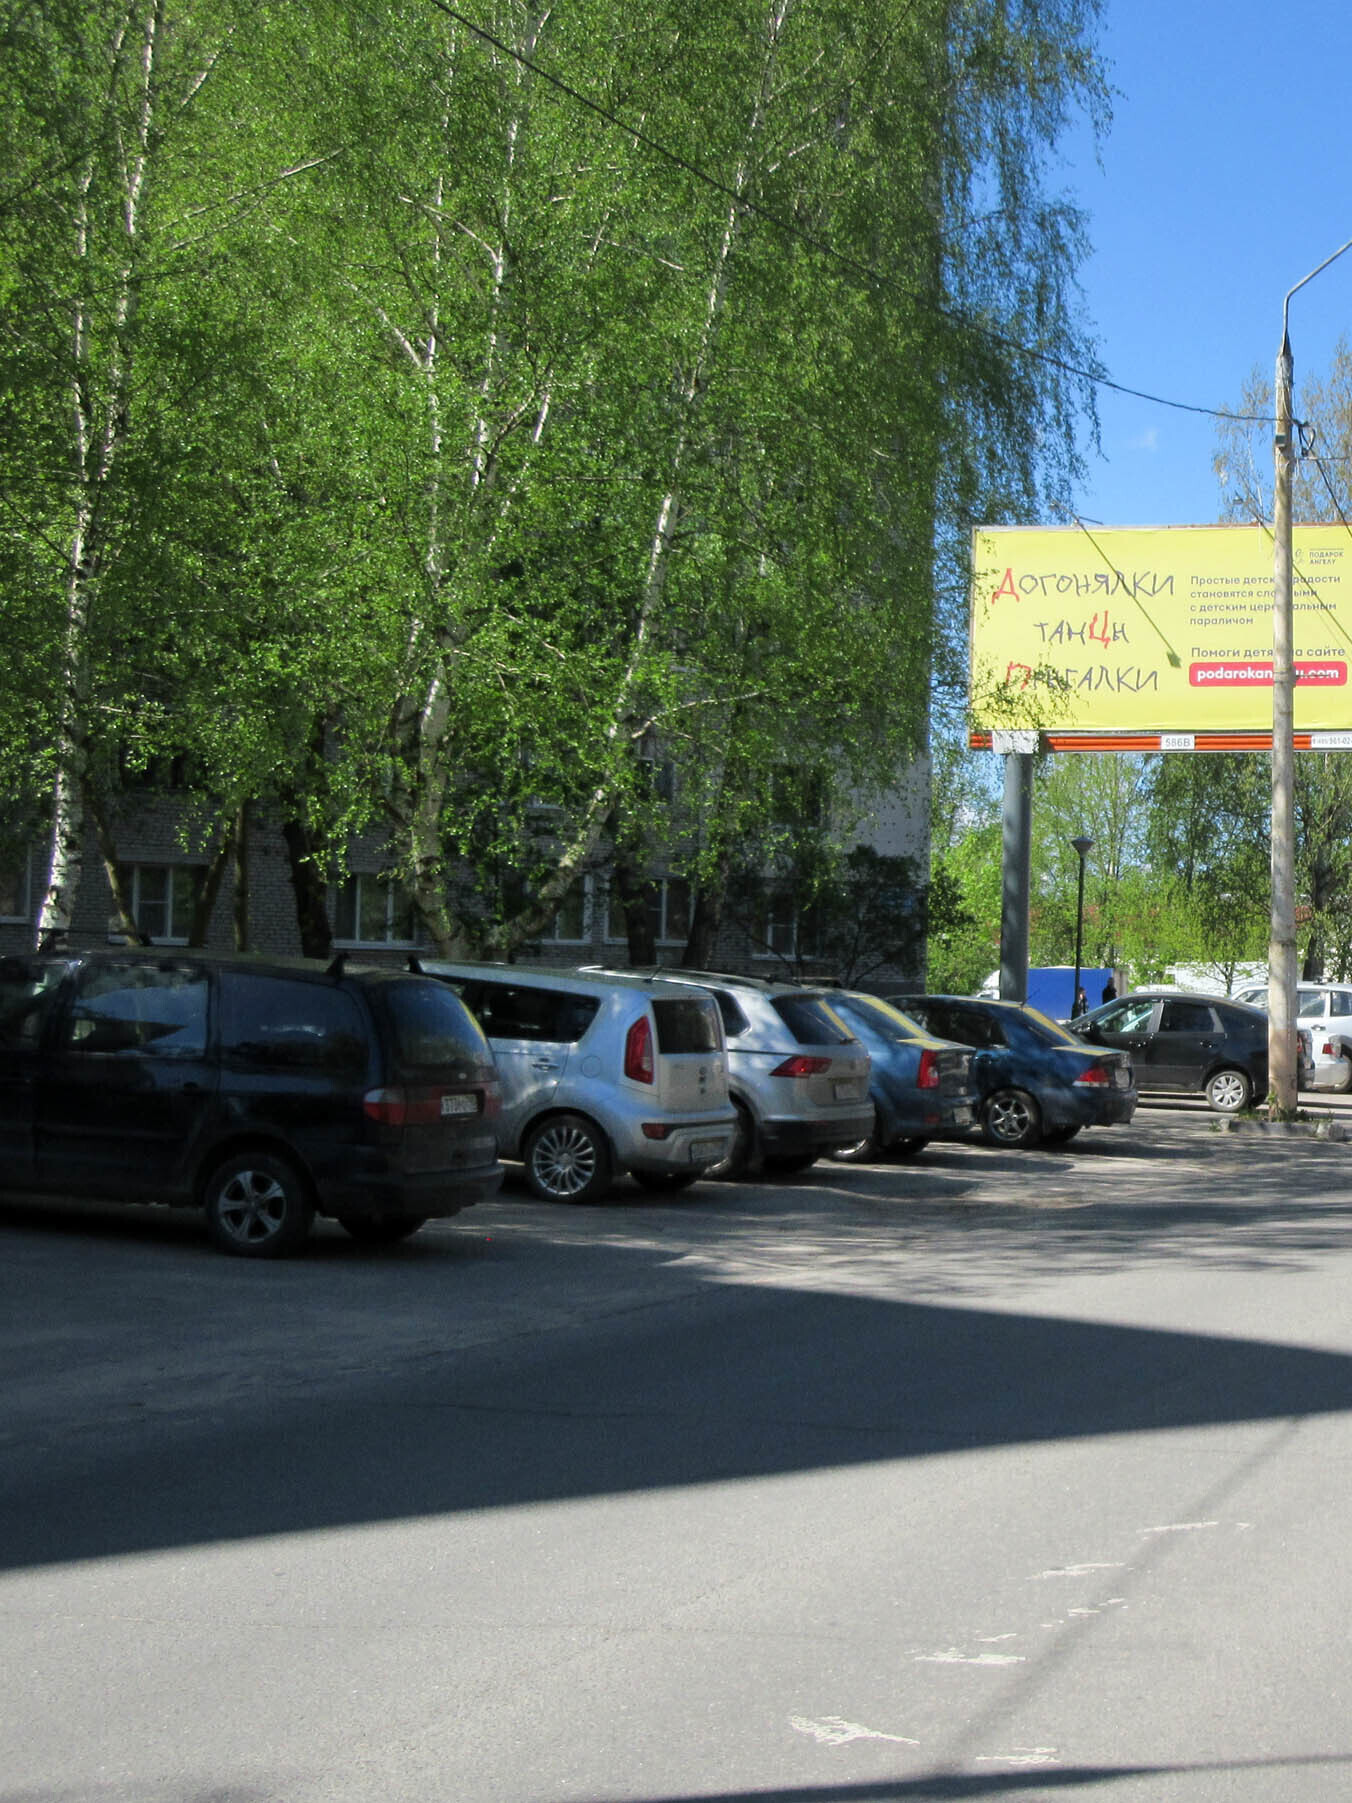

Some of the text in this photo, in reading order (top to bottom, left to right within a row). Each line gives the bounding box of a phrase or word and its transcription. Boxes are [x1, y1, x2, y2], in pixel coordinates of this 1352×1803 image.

[992, 567, 1174, 604] ДОГОНЯЛКИ
[1190, 575, 1341, 586] Простые детск радости
[1256, 590, 1317, 598] слоыми
[1190, 603, 1337, 612] с детским церальным
[1190, 616, 1253, 627] параличом
[1034, 610, 1129, 649] ТАНЦЫ
[1191, 647, 1240, 657] Помоги
[1243, 649, 1273, 658] детя
[1306, 645, 1345, 657] сайте
[1197, 666, 1339, 682] podarokanu.com
